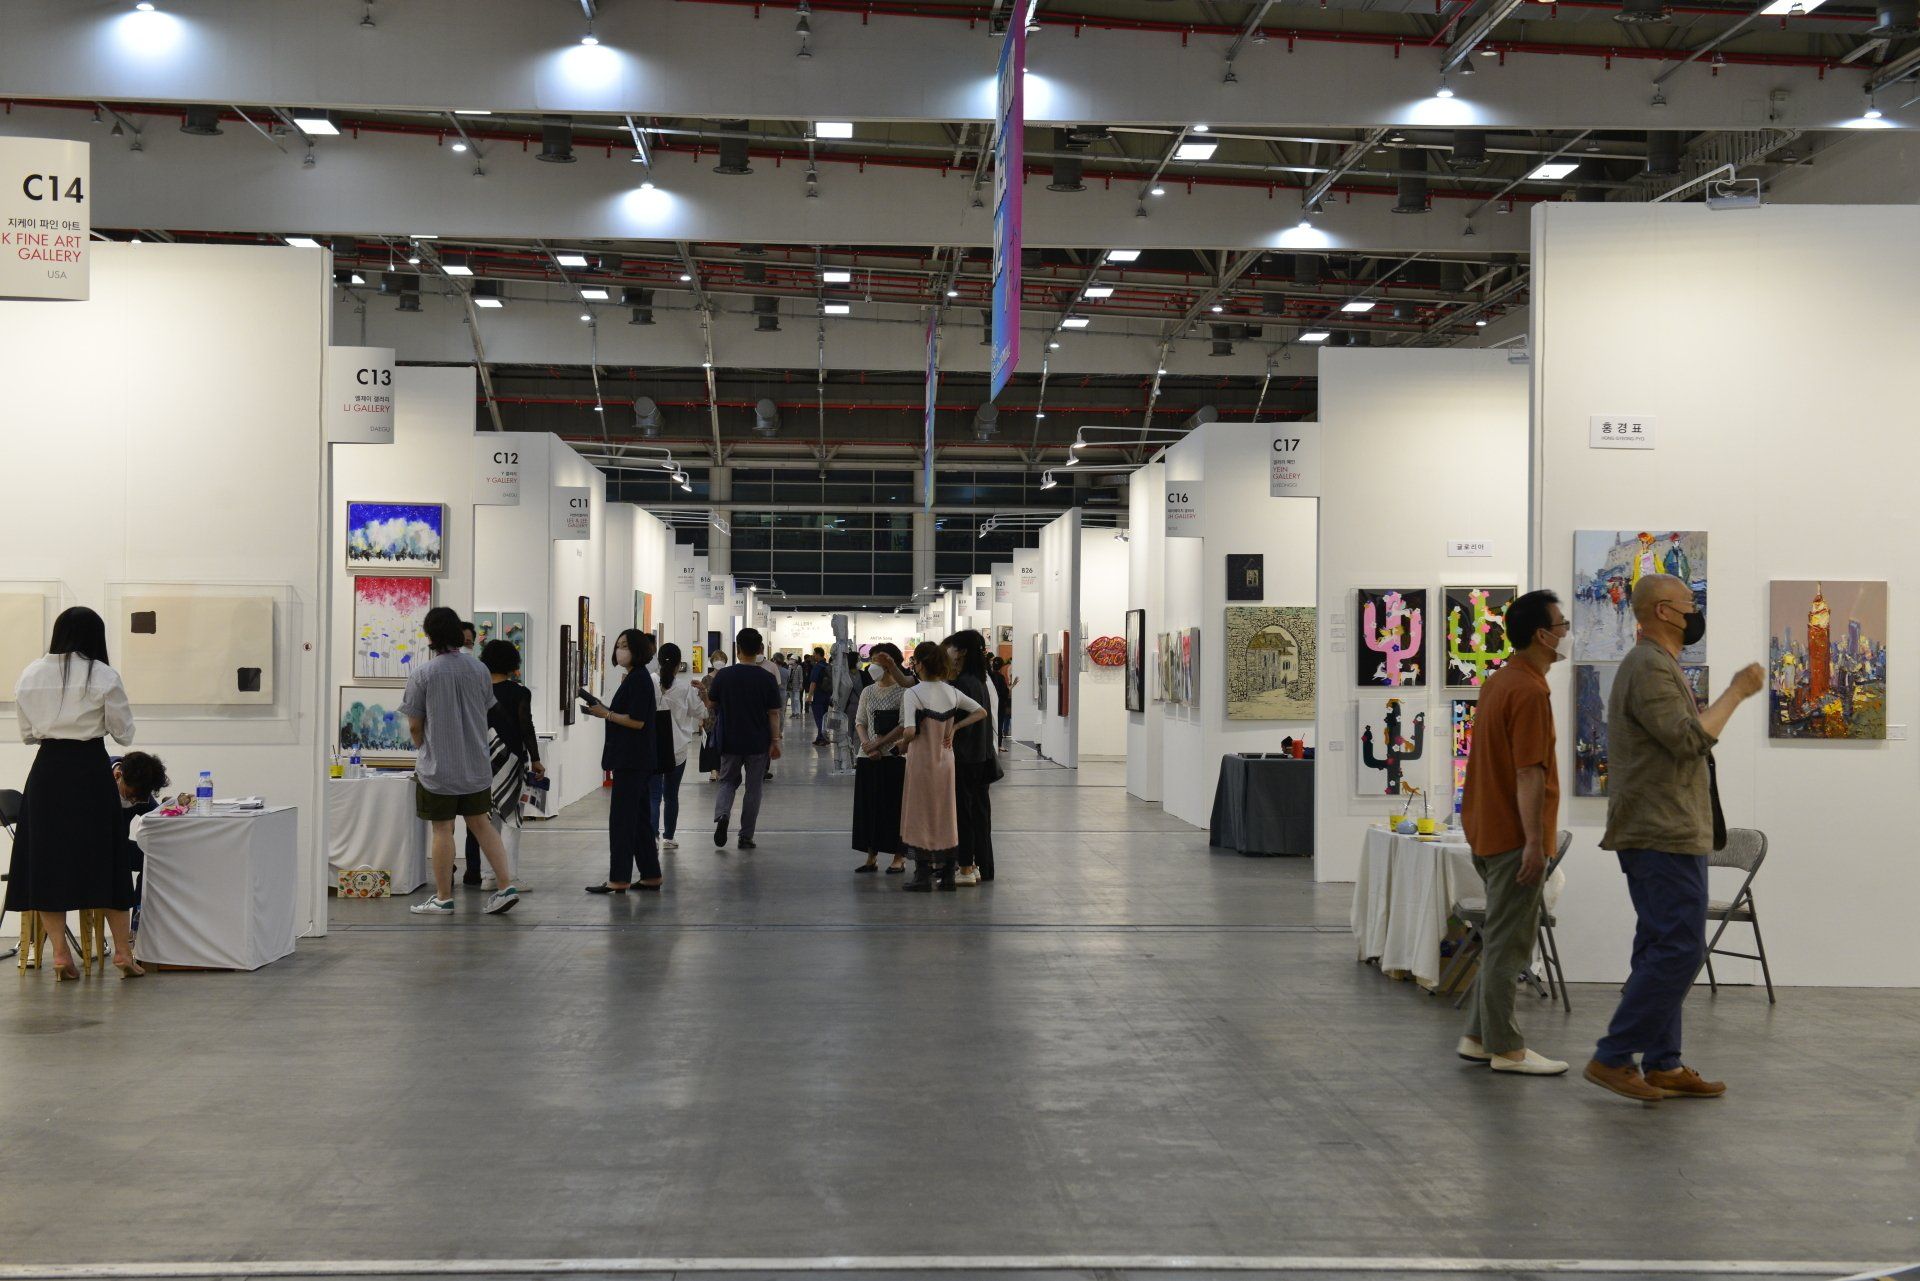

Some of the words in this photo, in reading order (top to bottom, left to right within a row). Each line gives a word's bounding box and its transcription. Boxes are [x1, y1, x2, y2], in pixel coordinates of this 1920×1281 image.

[23, 174, 84, 203] C14
[8, 217, 37, 229] 지케이
[40, 219, 59, 230] 파인
[62, 220, 81, 231] 아트
[16, 233, 49, 247] FINE
[54, 235, 82, 249] ART
[18, 247, 82, 263] GALLERY
[47, 269, 68, 279] USA
[356, 368, 392, 386] C13
[353, 404, 390, 413] GALLERY
[1272, 438, 1301, 452] C17
[493, 451, 519, 465] C12
[1272, 472, 1301, 480] GALLERY
[569, 498, 588, 508] C11
[1167, 492, 1189, 503] C16
